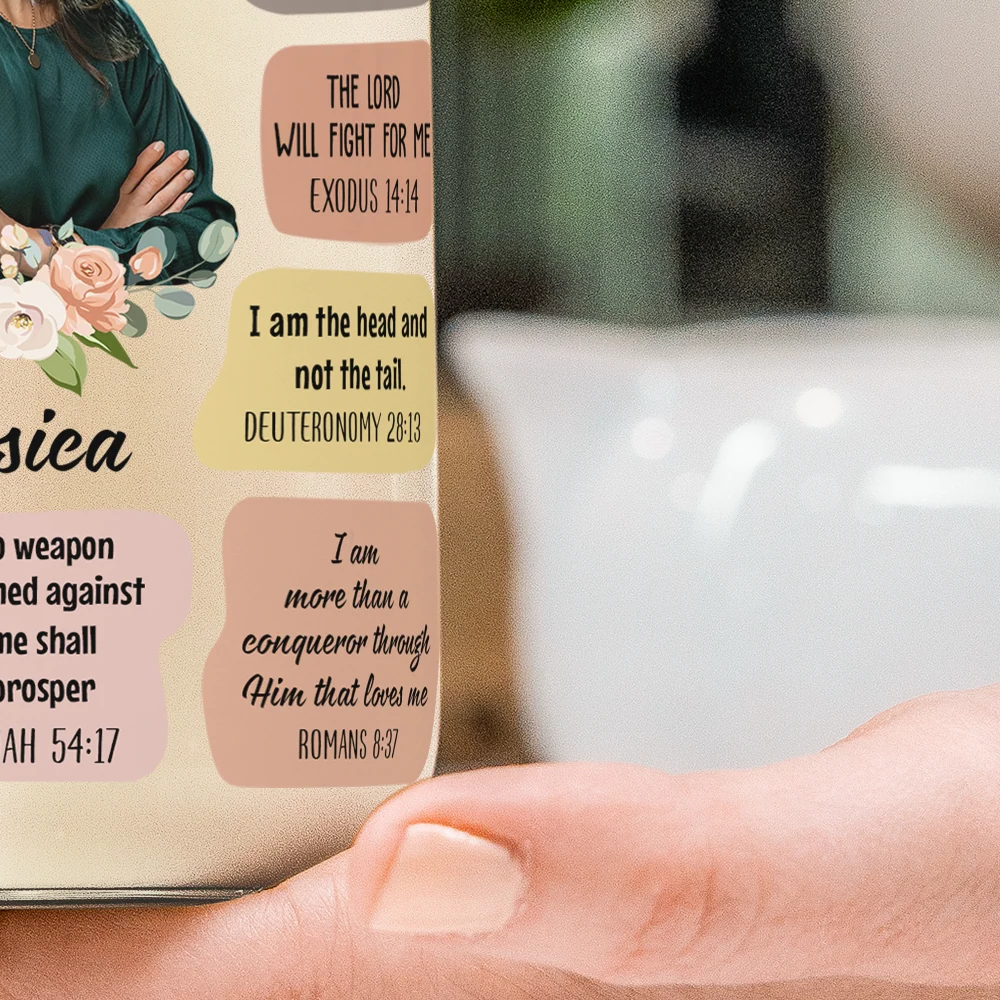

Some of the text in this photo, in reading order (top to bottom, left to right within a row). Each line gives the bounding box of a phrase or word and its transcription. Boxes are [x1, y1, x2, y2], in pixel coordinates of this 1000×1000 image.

[326, 73, 401, 110] THE LORD
[274, 121, 431, 159] WILL FIGHT FOR ME
[310, 177, 419, 214] EXODUS 14:14
[249, 305, 428, 339] I am the head and
[295, 357, 406, 391] not the tail.
[244, 411, 421, 443] DEUTERONOMY 28:13
[13, 536, 114, 567] weapon
[330, 531, 380, 565] I am
[45, 574, 146, 612] against
[284, 578, 409, 610] more than a
[36, 625, 97, 655] shall
[241, 623, 431, 673] conqueror through
[241, 672, 428, 709] Him that loves me
[52, 727, 120, 764] 54:17
[298, 728, 399, 760] ROMANS 8:37
